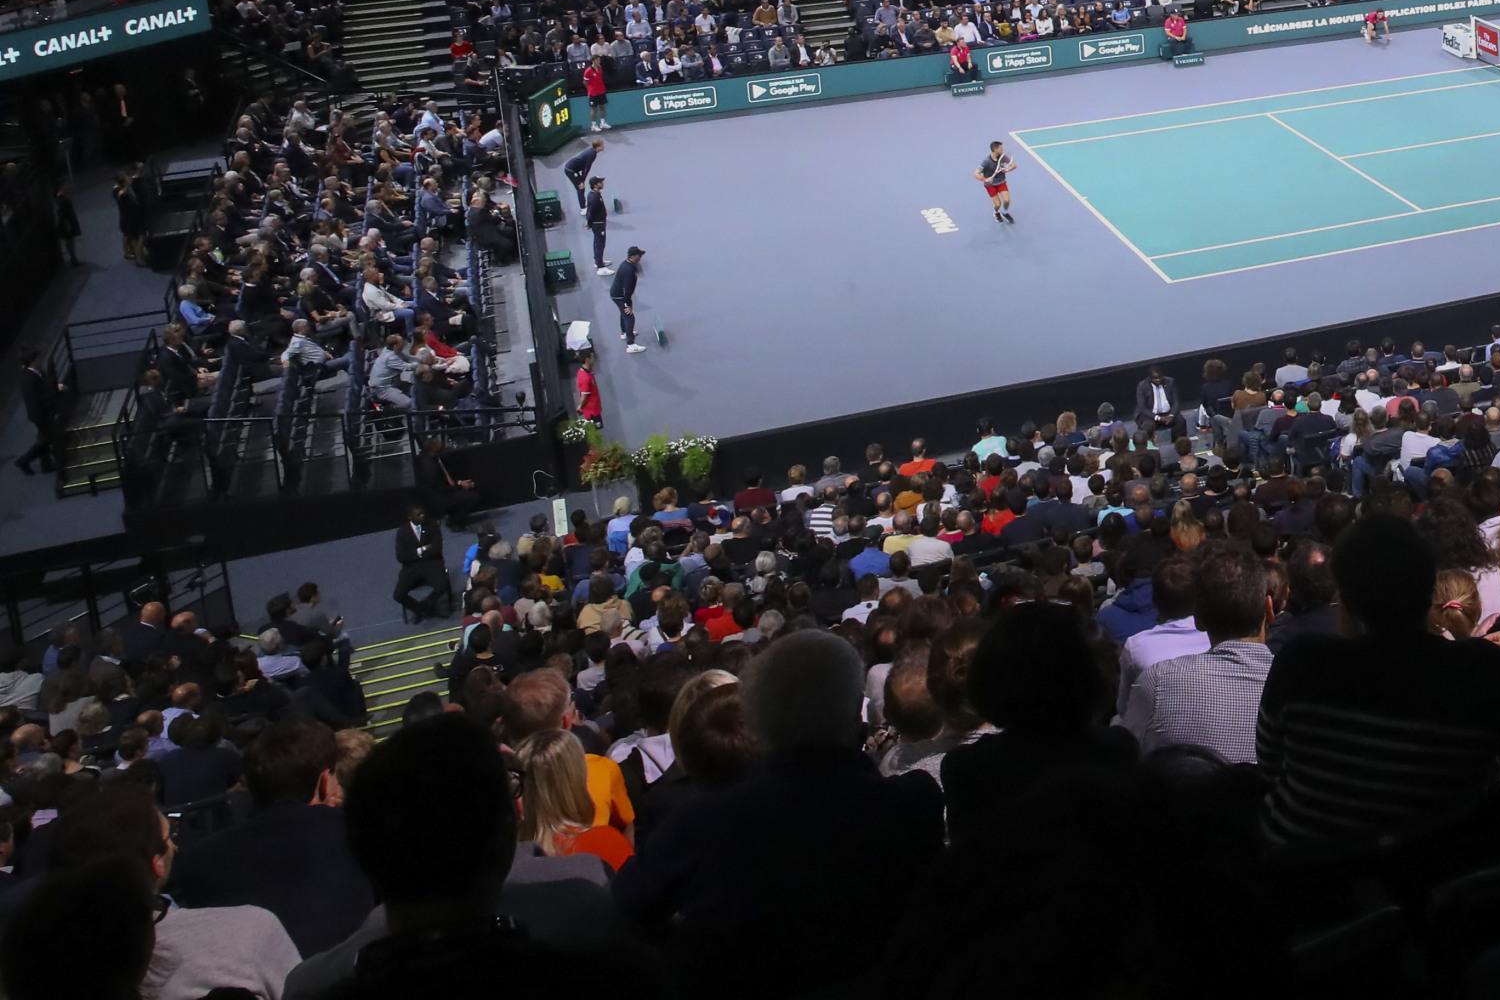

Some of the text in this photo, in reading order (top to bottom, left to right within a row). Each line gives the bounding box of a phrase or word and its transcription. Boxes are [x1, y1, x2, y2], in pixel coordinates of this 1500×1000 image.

[125, 6, 198, 35] CANAL+
[1246, 20, 1314, 36] TÉLÉCHARGEZ
[1315, 18, 1328, 27] LA
[1438, 1, 1466, 12] ROLEX
[34, 25, 113, 57] CANAL+
[1443, 32, 1460, 51] FedEx
[1099, 43, 1140, 55] Google Play
[1026, 56, 1047, 65] Store
[770, 83, 816, 95] Google Play
[663, 97, 711, 109] l'App Store
